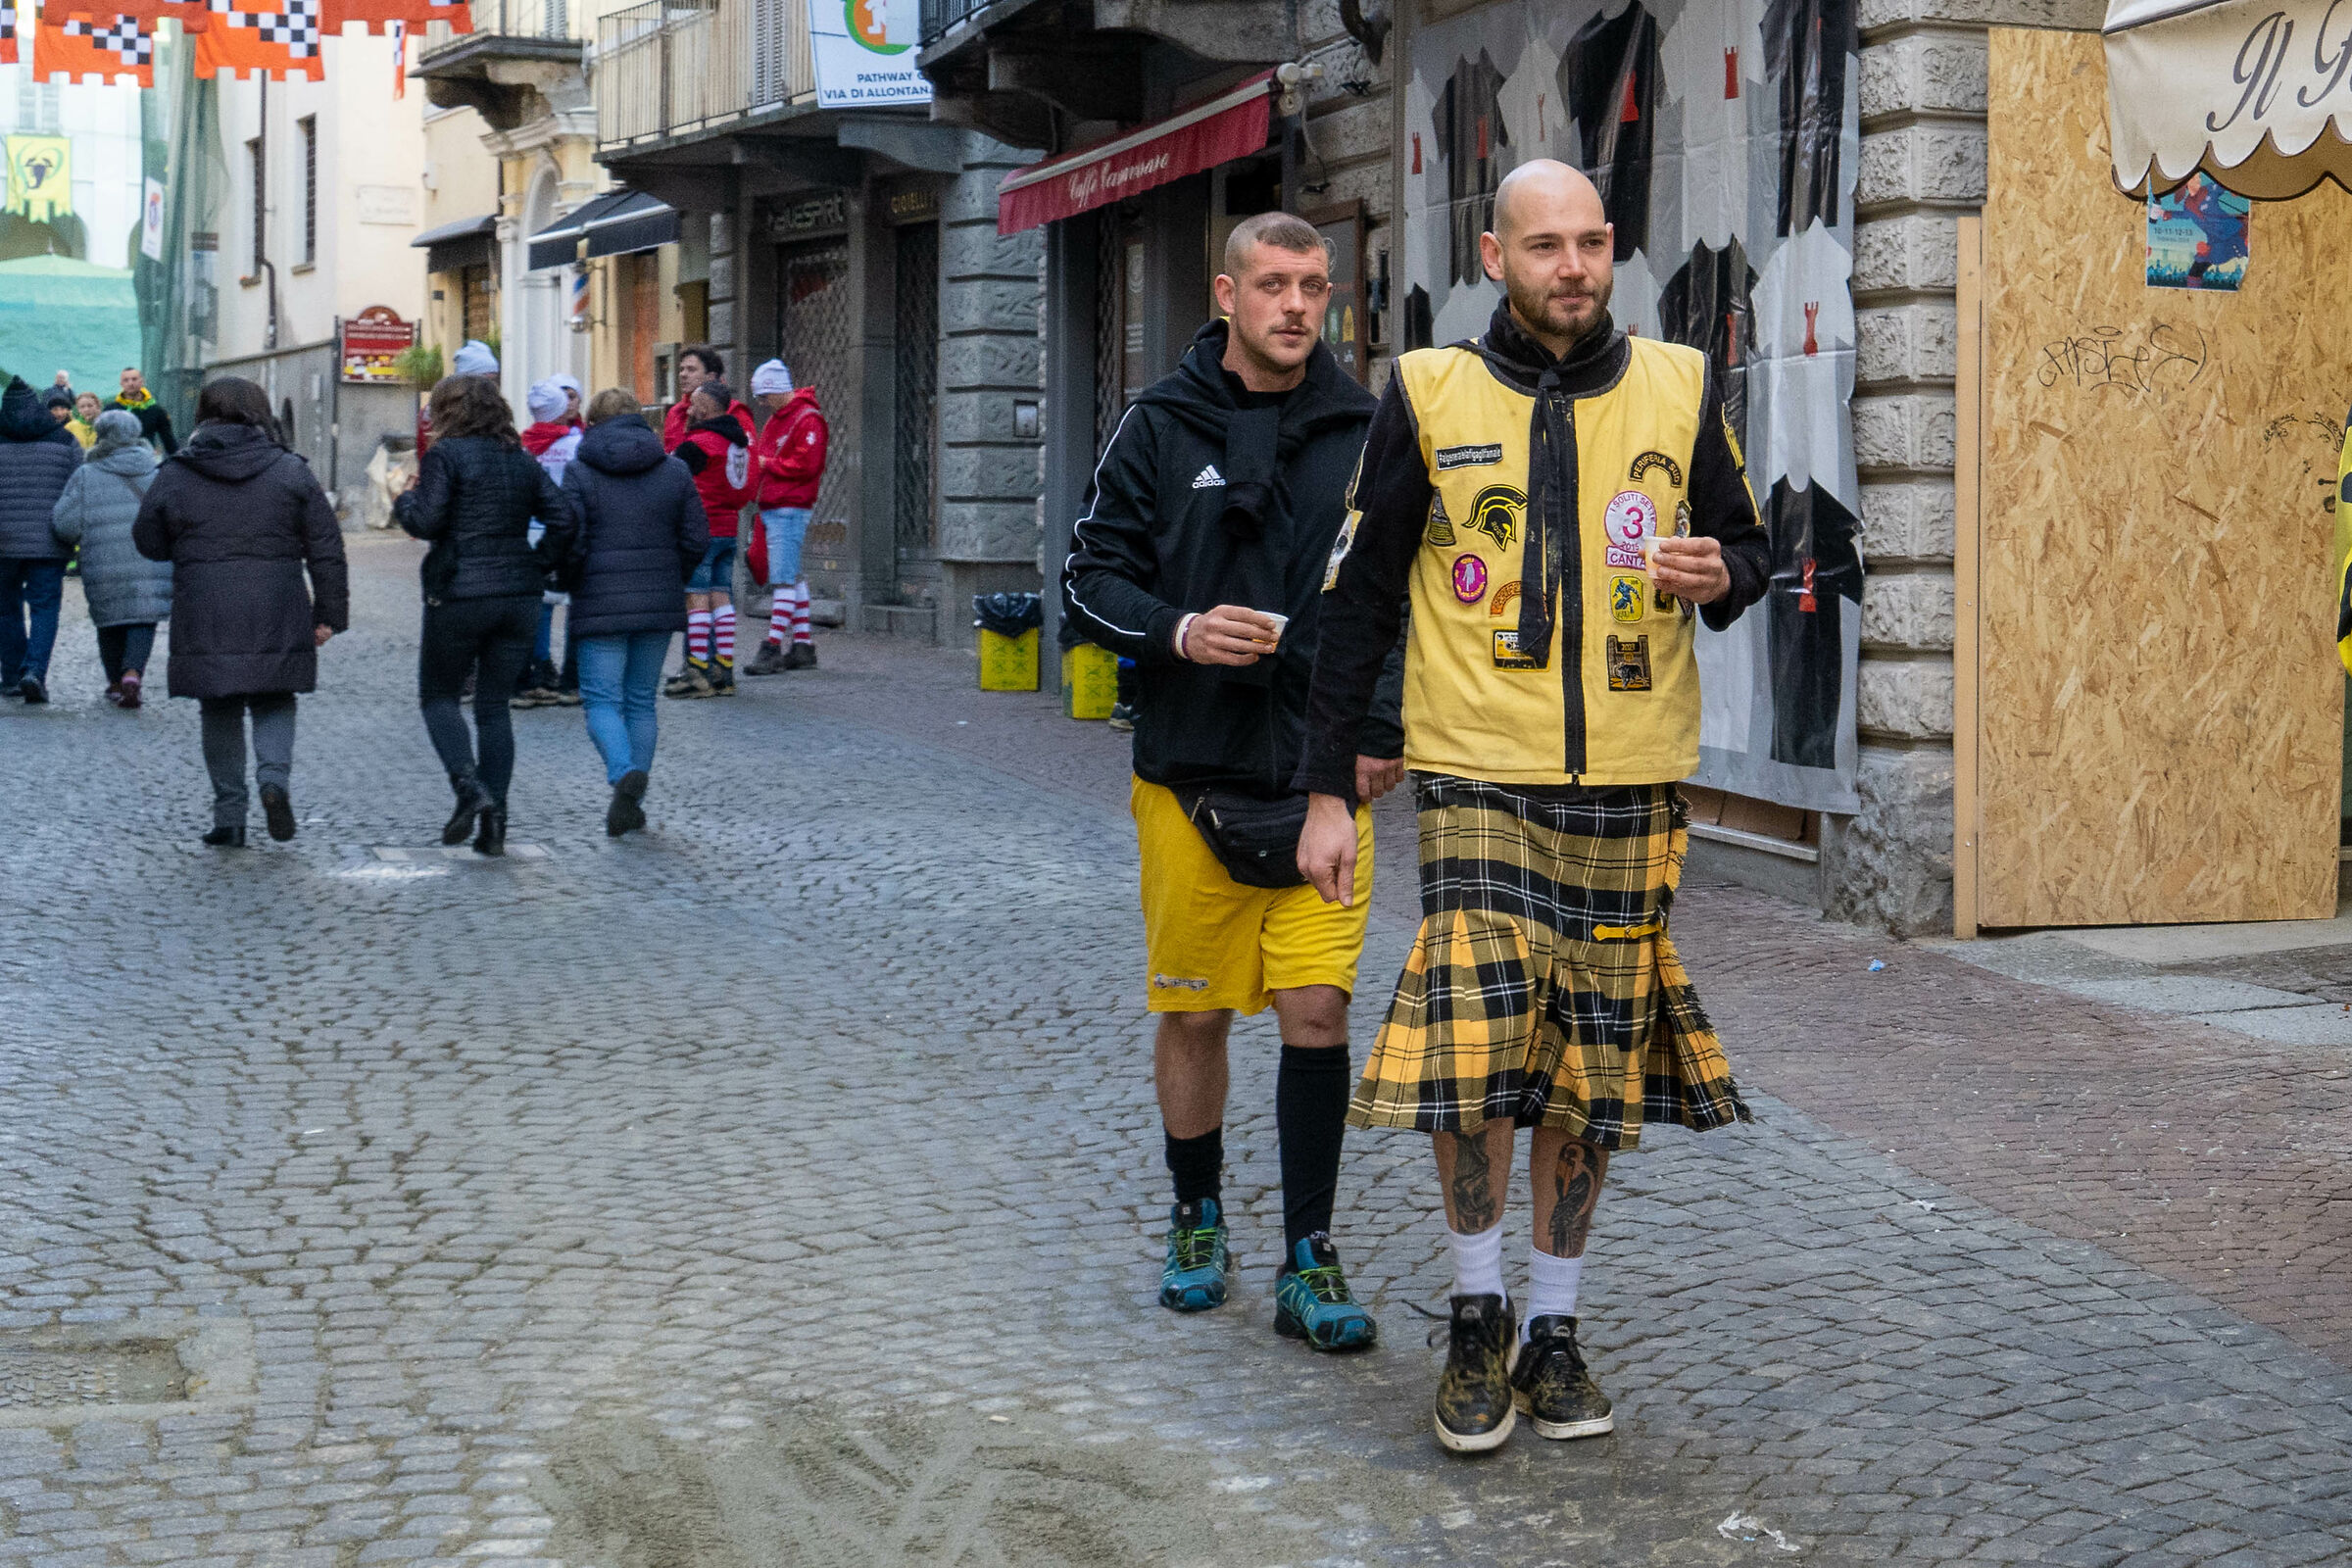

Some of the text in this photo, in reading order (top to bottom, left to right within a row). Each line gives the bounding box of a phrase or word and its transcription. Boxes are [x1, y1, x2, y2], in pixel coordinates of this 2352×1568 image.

[857, 72, 912, 83] PATHWAY
[823, 85, 932, 99] VIA DI ALLONTAN
[1633, 454, 1681, 482] PERIFERIA SUD
[1192, 478, 1226, 489] adidas
[1613, 493, 1639, 508] SOLITI
[1491, 520, 1504, 539] 2020
[1623, 507, 1643, 539] 3
[1620, 541, 1640, 551] 2015
